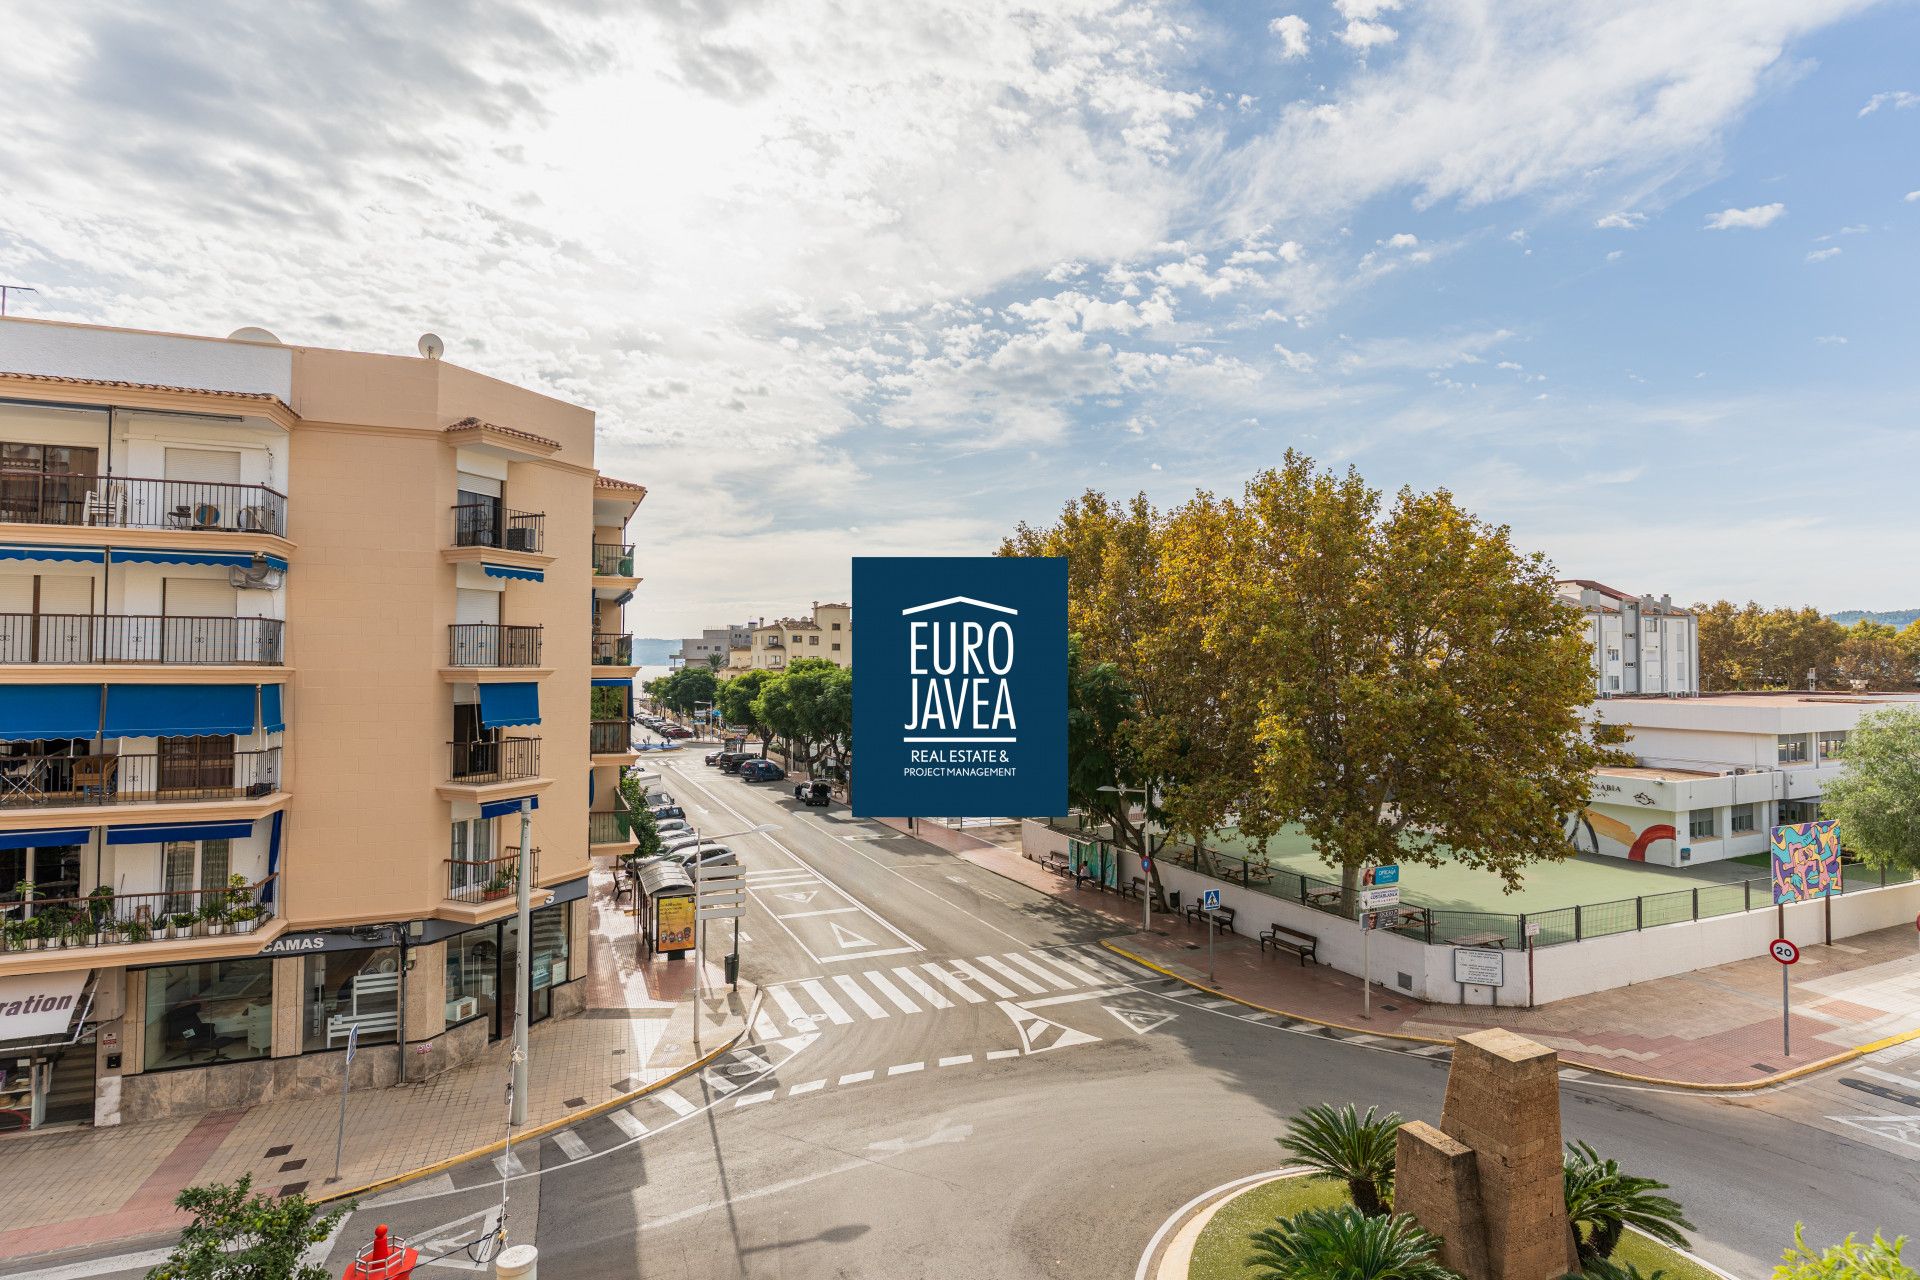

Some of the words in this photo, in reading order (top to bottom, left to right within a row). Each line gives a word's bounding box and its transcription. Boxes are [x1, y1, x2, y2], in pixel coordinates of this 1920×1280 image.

[261, 937, 325, 953] CAMAS
[1775, 946, 1792, 957] 20
[0, 994, 73, 1017] ration
